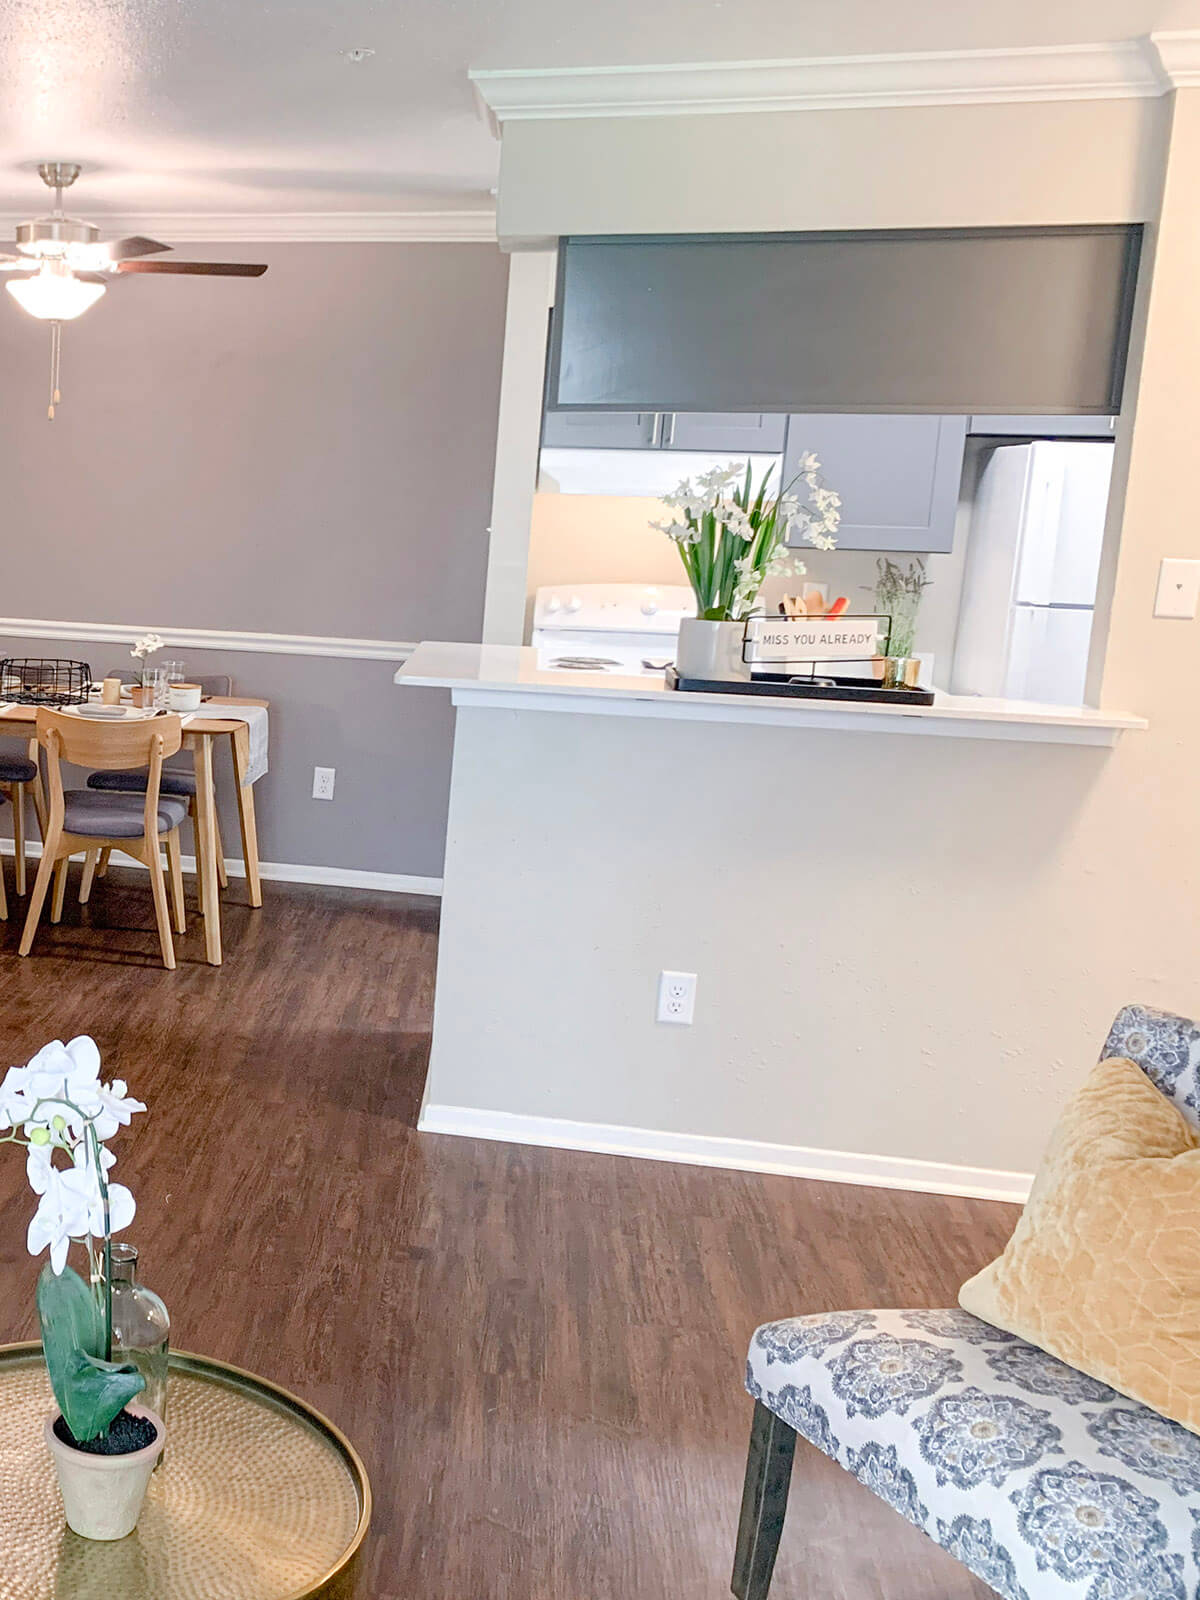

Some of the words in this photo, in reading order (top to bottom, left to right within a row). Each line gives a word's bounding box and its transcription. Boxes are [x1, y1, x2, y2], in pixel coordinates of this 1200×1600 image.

[763, 635, 789, 645] MISS
[794, 634, 816, 645] YOU
[820, 634, 872, 644] ALREADY
